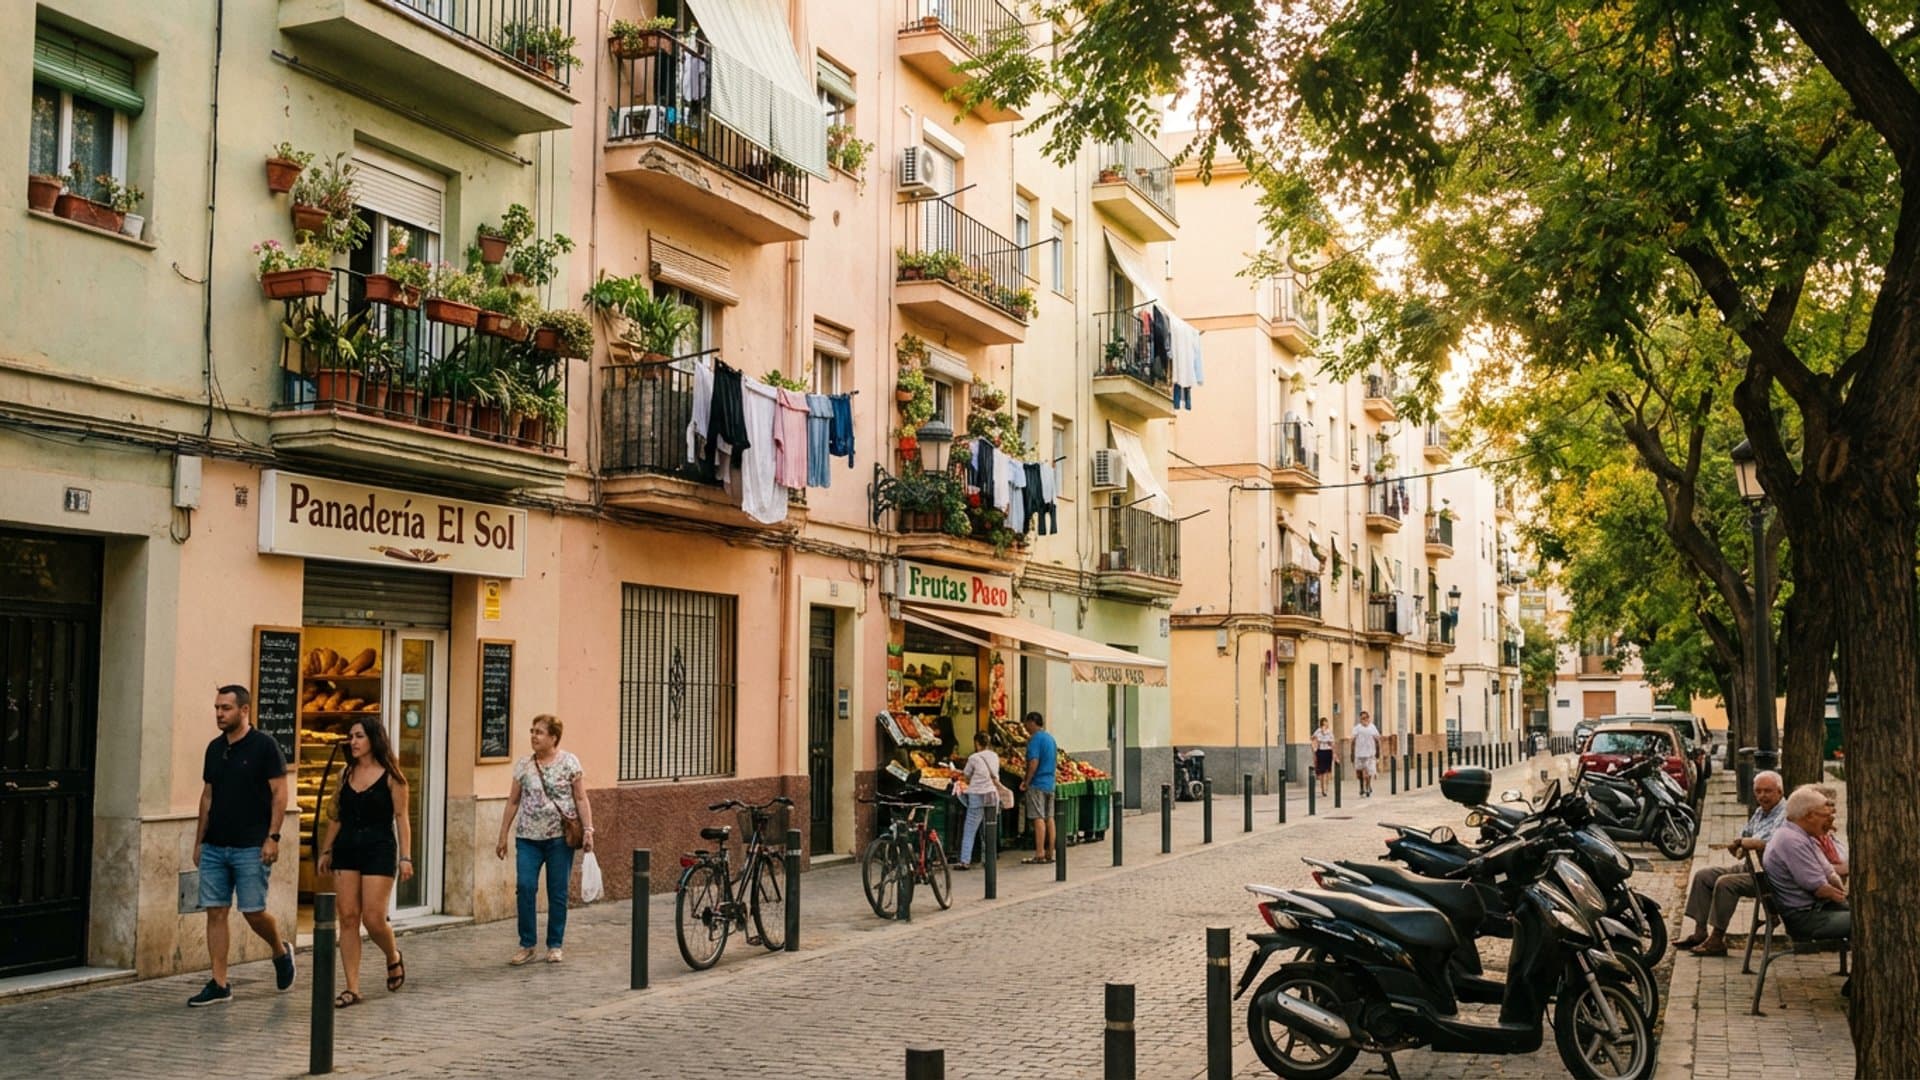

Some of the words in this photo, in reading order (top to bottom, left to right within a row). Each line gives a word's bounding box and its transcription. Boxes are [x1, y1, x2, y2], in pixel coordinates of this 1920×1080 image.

[289, 483, 425, 540] Panadería
[437, 504, 465, 544] El
[474, 510, 515, 550] Sol
[909, 566, 967, 603] Frutas
